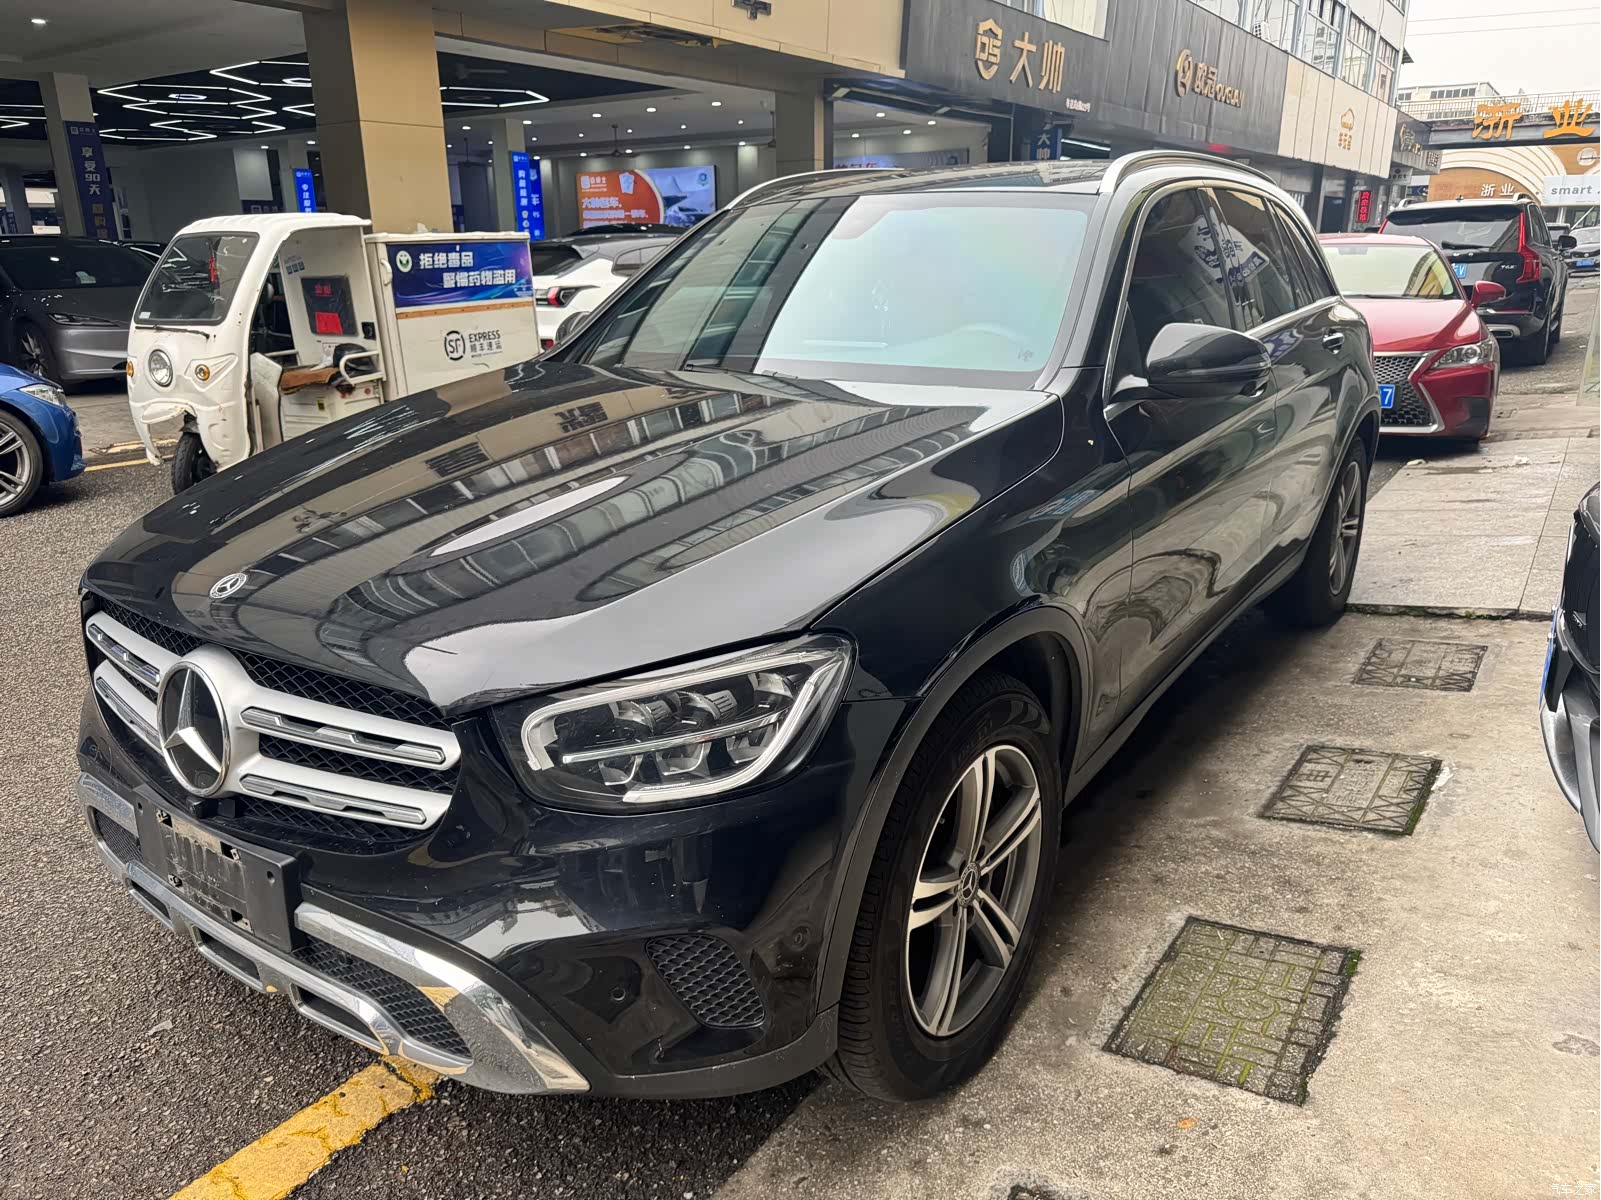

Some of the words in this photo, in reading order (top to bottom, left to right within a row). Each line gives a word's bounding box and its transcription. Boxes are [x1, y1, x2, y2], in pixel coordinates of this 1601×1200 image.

[1009, 31, 1066, 94] 大帅
[1481, 183, 1515, 196] 浙业
[1551, 185, 1593, 195] smart
[419, 251, 474, 269] 拒绝毒品
[442, 269, 516, 289] 警惕药物滥用
[468, 329, 501, 343] EXPRESS
[470, 341, 502, 353] 顺丰速运
[1383, 388, 1393, 405] 7
